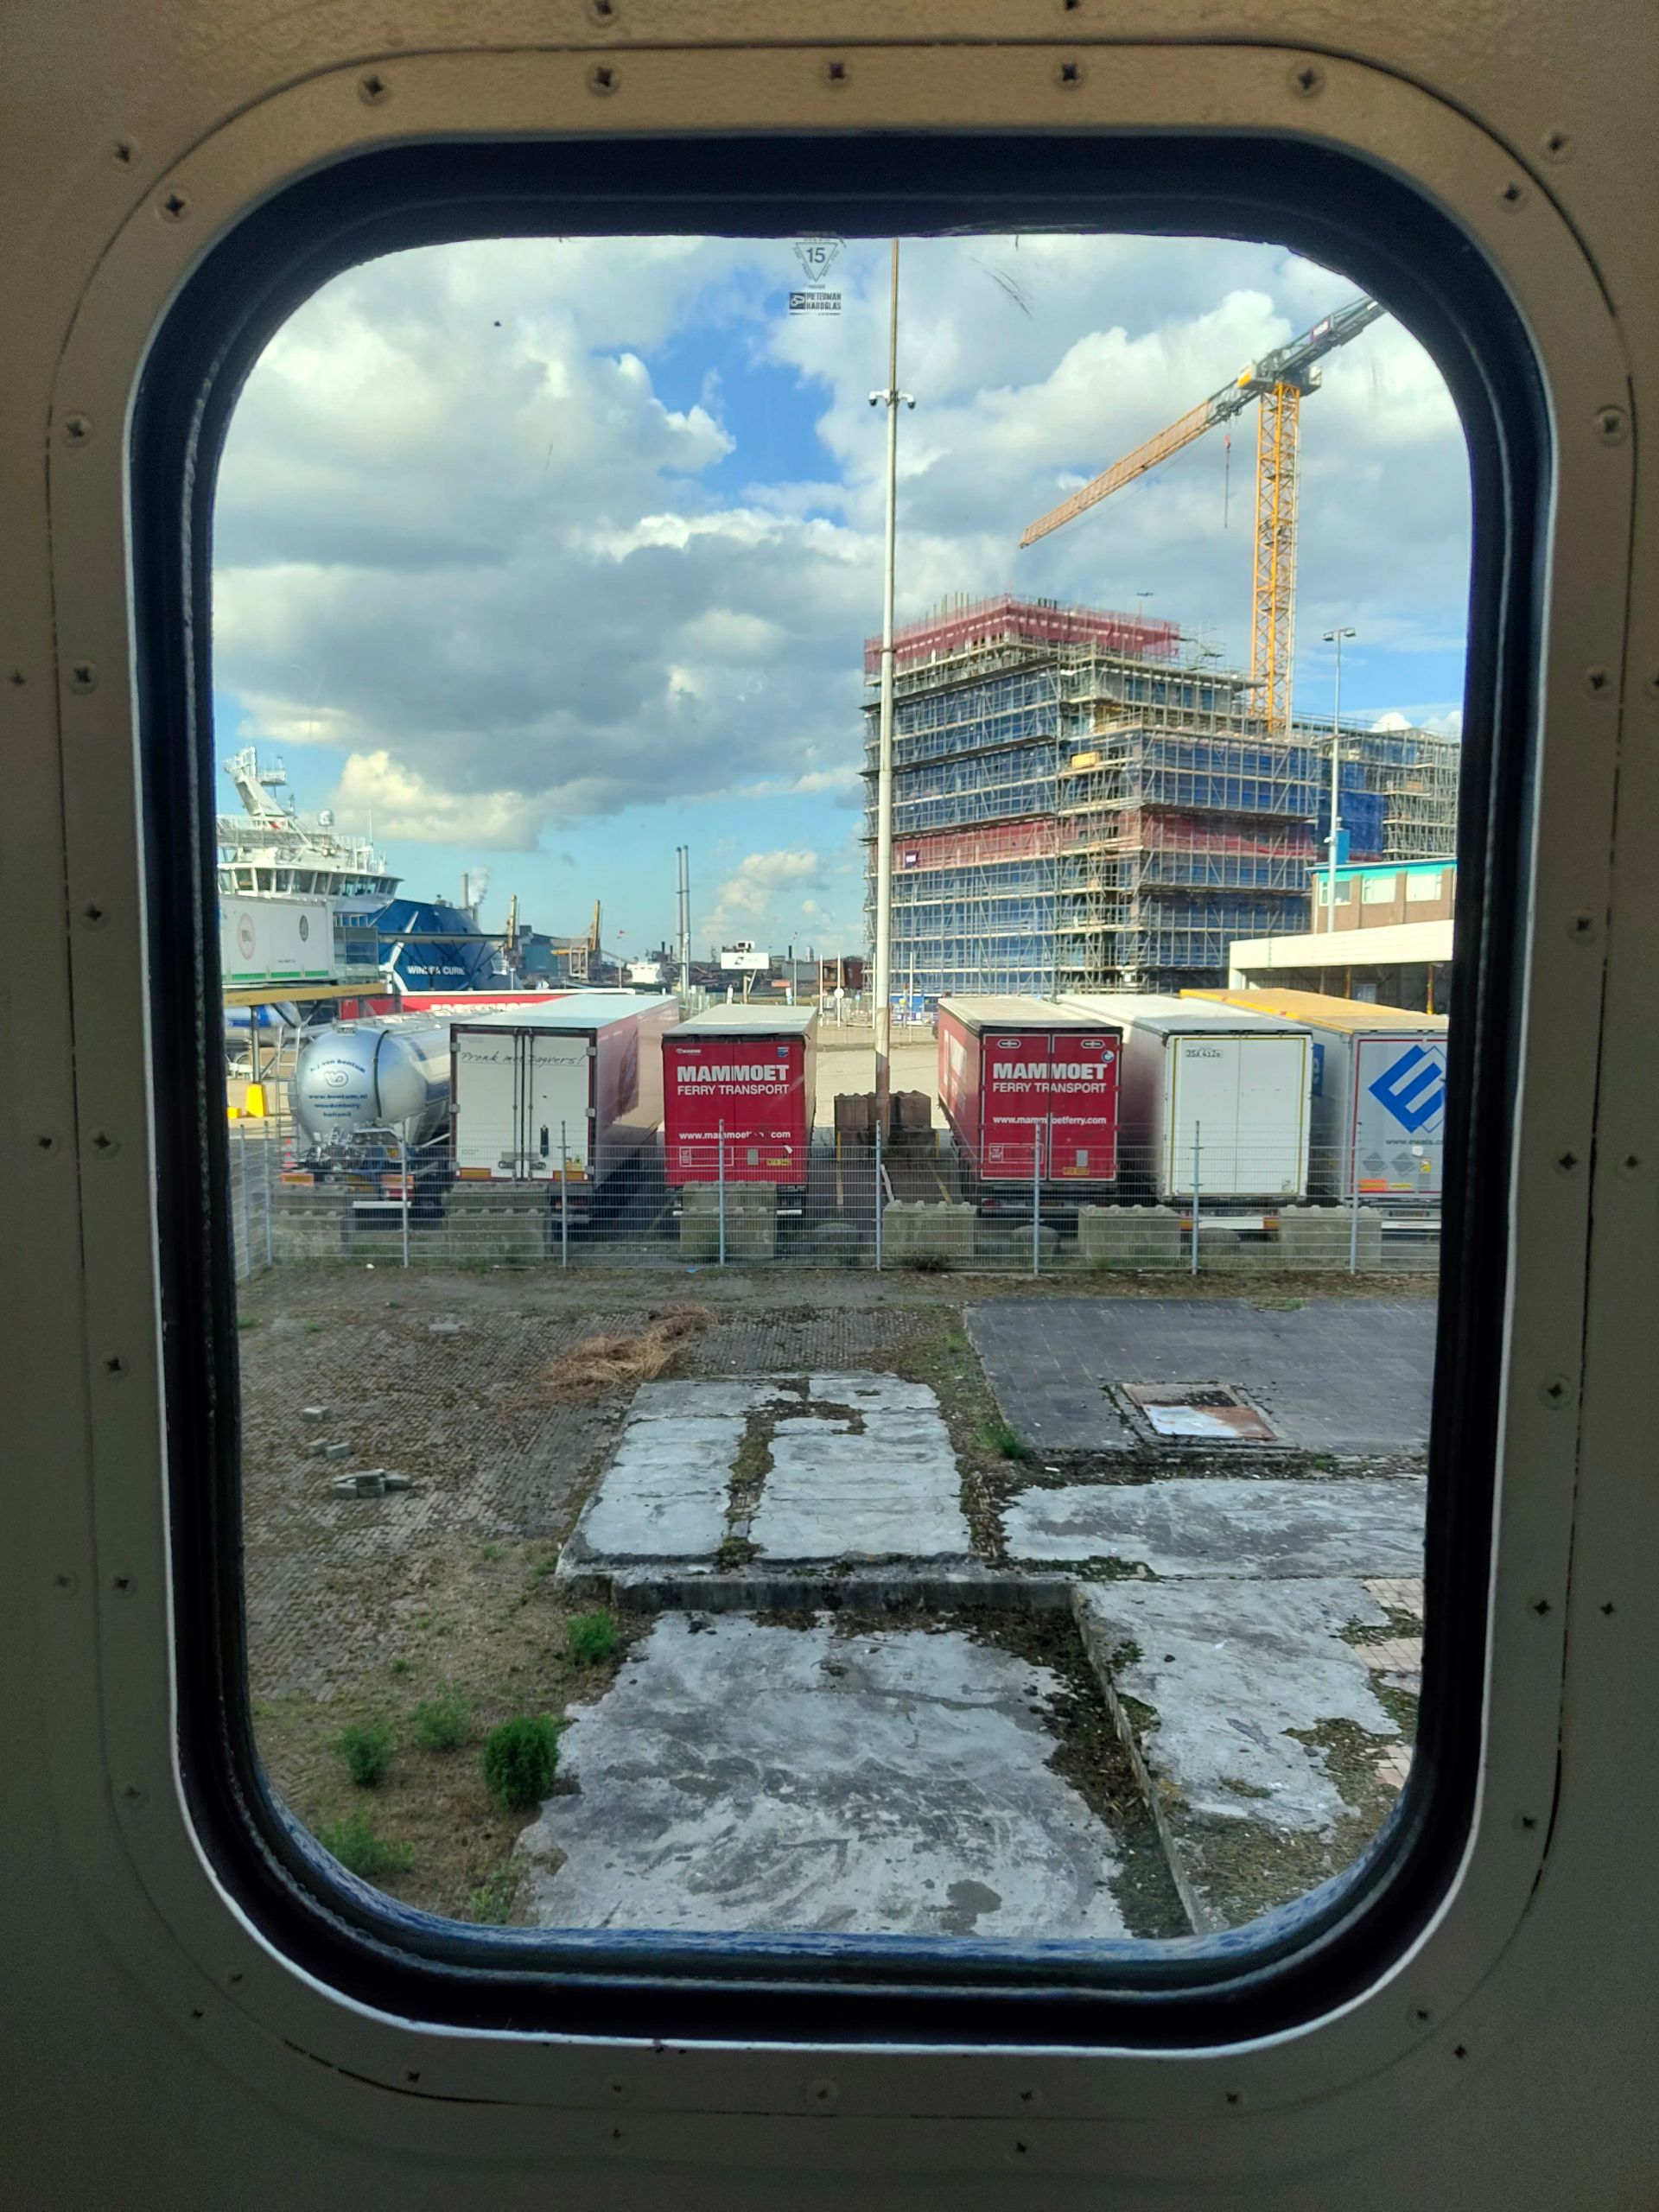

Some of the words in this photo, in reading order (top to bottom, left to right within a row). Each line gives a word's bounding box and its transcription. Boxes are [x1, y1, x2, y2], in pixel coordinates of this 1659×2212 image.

[806, 247, 826, 264] 15
[677, 1065, 790, 1082] MAMMOET
[993, 1063, 1108, 1080] MAMMOET
[677, 1085, 715, 1096] FERRY
[719, 1084, 790, 1096] TRANSPORT
[993, 1083, 1031, 1093] FERRY
[1034, 1083, 1107, 1093] TRANSPORT
